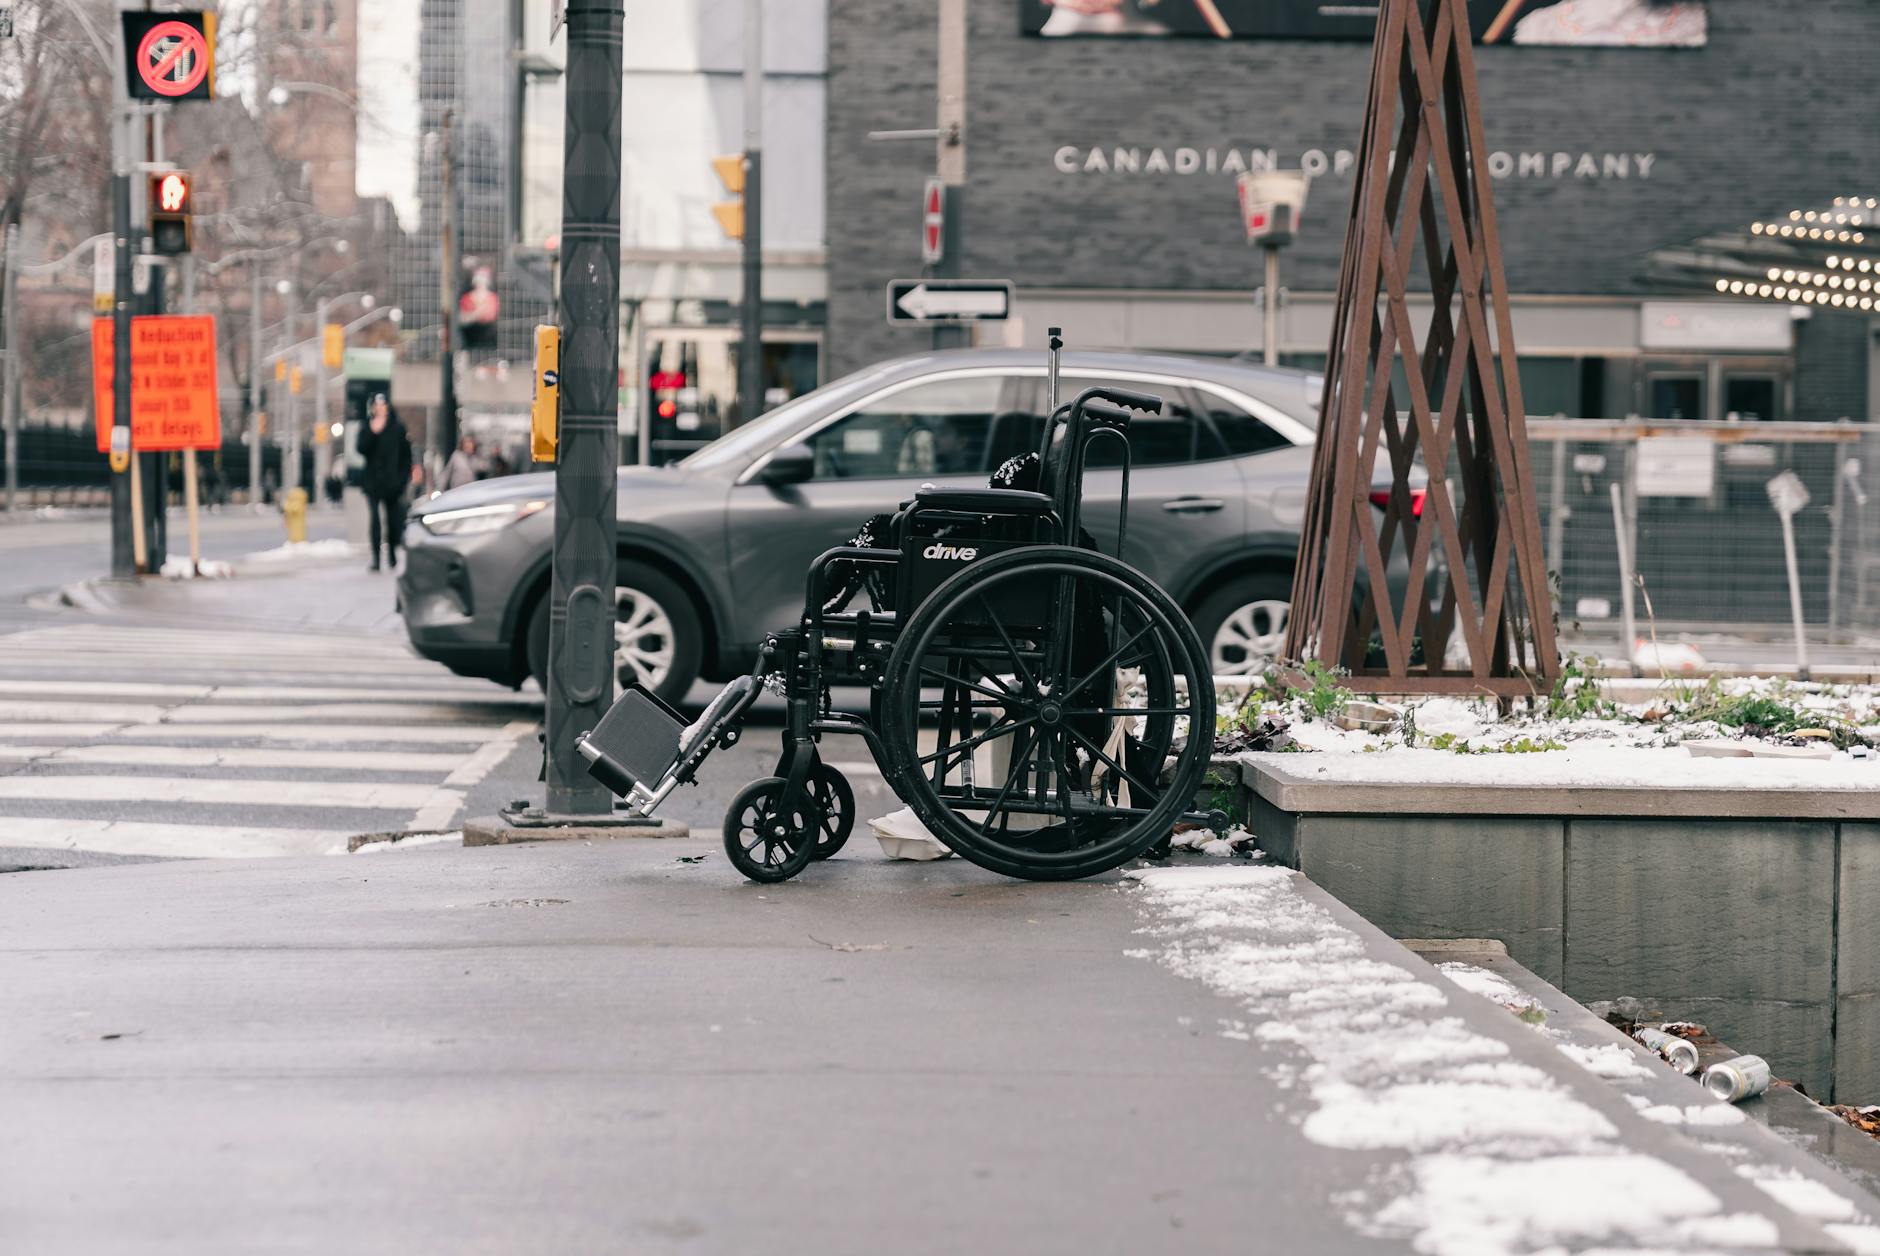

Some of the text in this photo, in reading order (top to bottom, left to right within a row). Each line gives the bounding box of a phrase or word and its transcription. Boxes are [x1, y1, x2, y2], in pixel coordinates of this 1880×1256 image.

[1054, 146, 1277, 175] CANADIAN
[1465, 150, 1656, 179] OMPANY
[923, 543, 977, 561] drive
